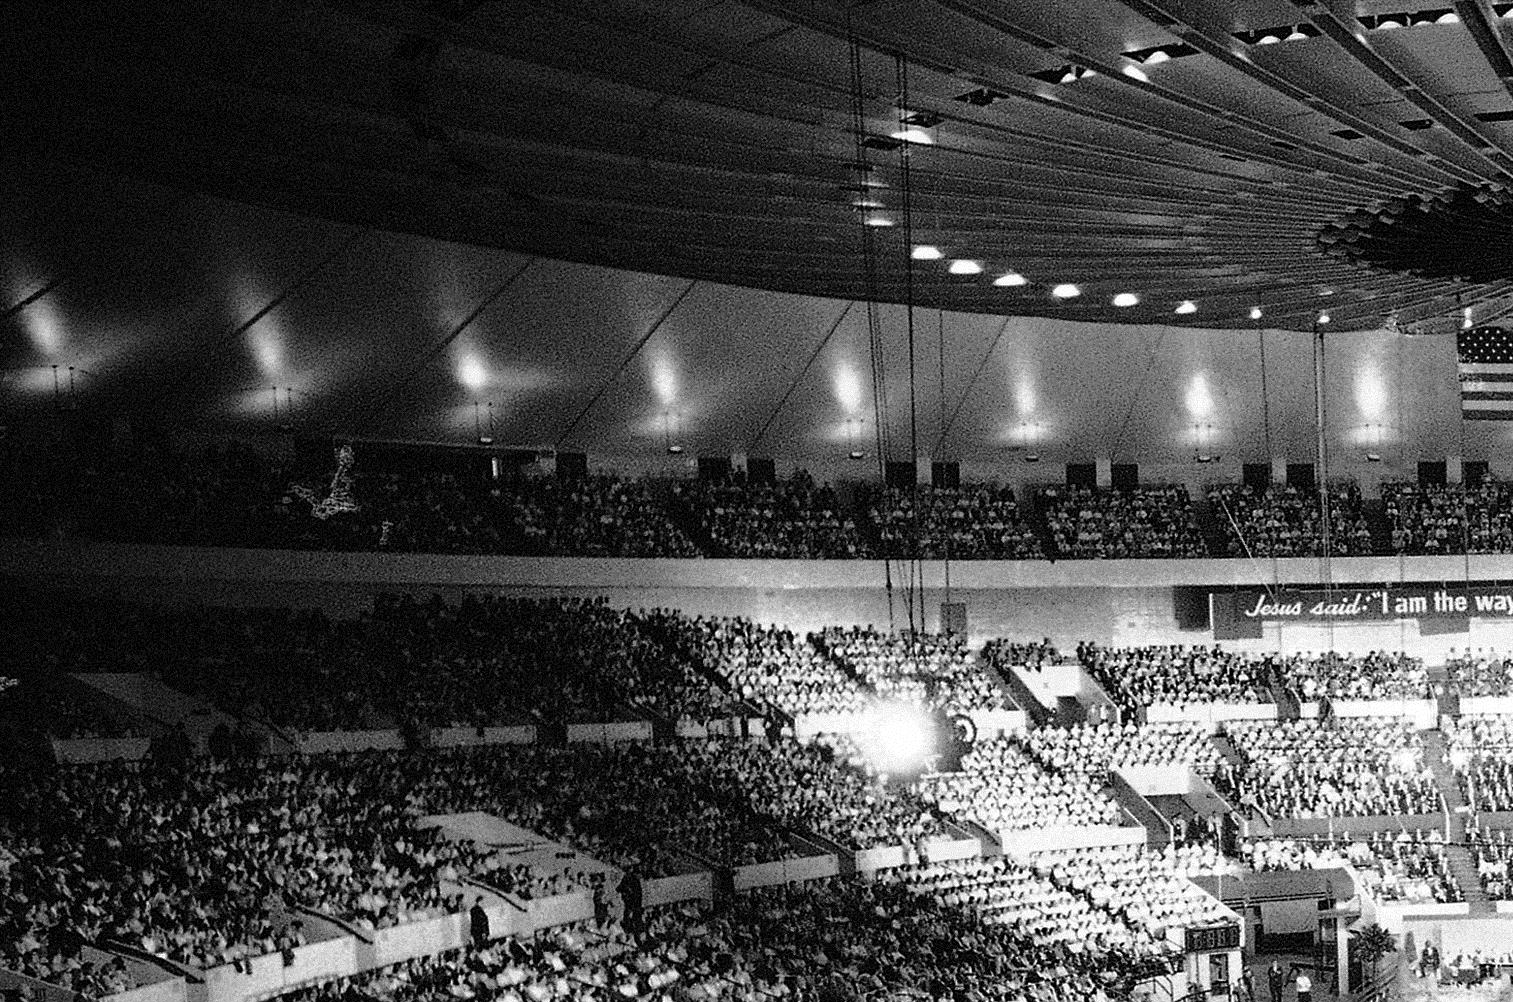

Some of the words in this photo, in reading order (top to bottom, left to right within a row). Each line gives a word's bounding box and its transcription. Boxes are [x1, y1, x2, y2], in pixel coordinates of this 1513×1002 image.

[1245, 594, 1303, 617] Jesus
[1310, 592, 1371, 615] said:
[1395, 596, 1428, 613] am
[1434, 590, 1468, 612] the
